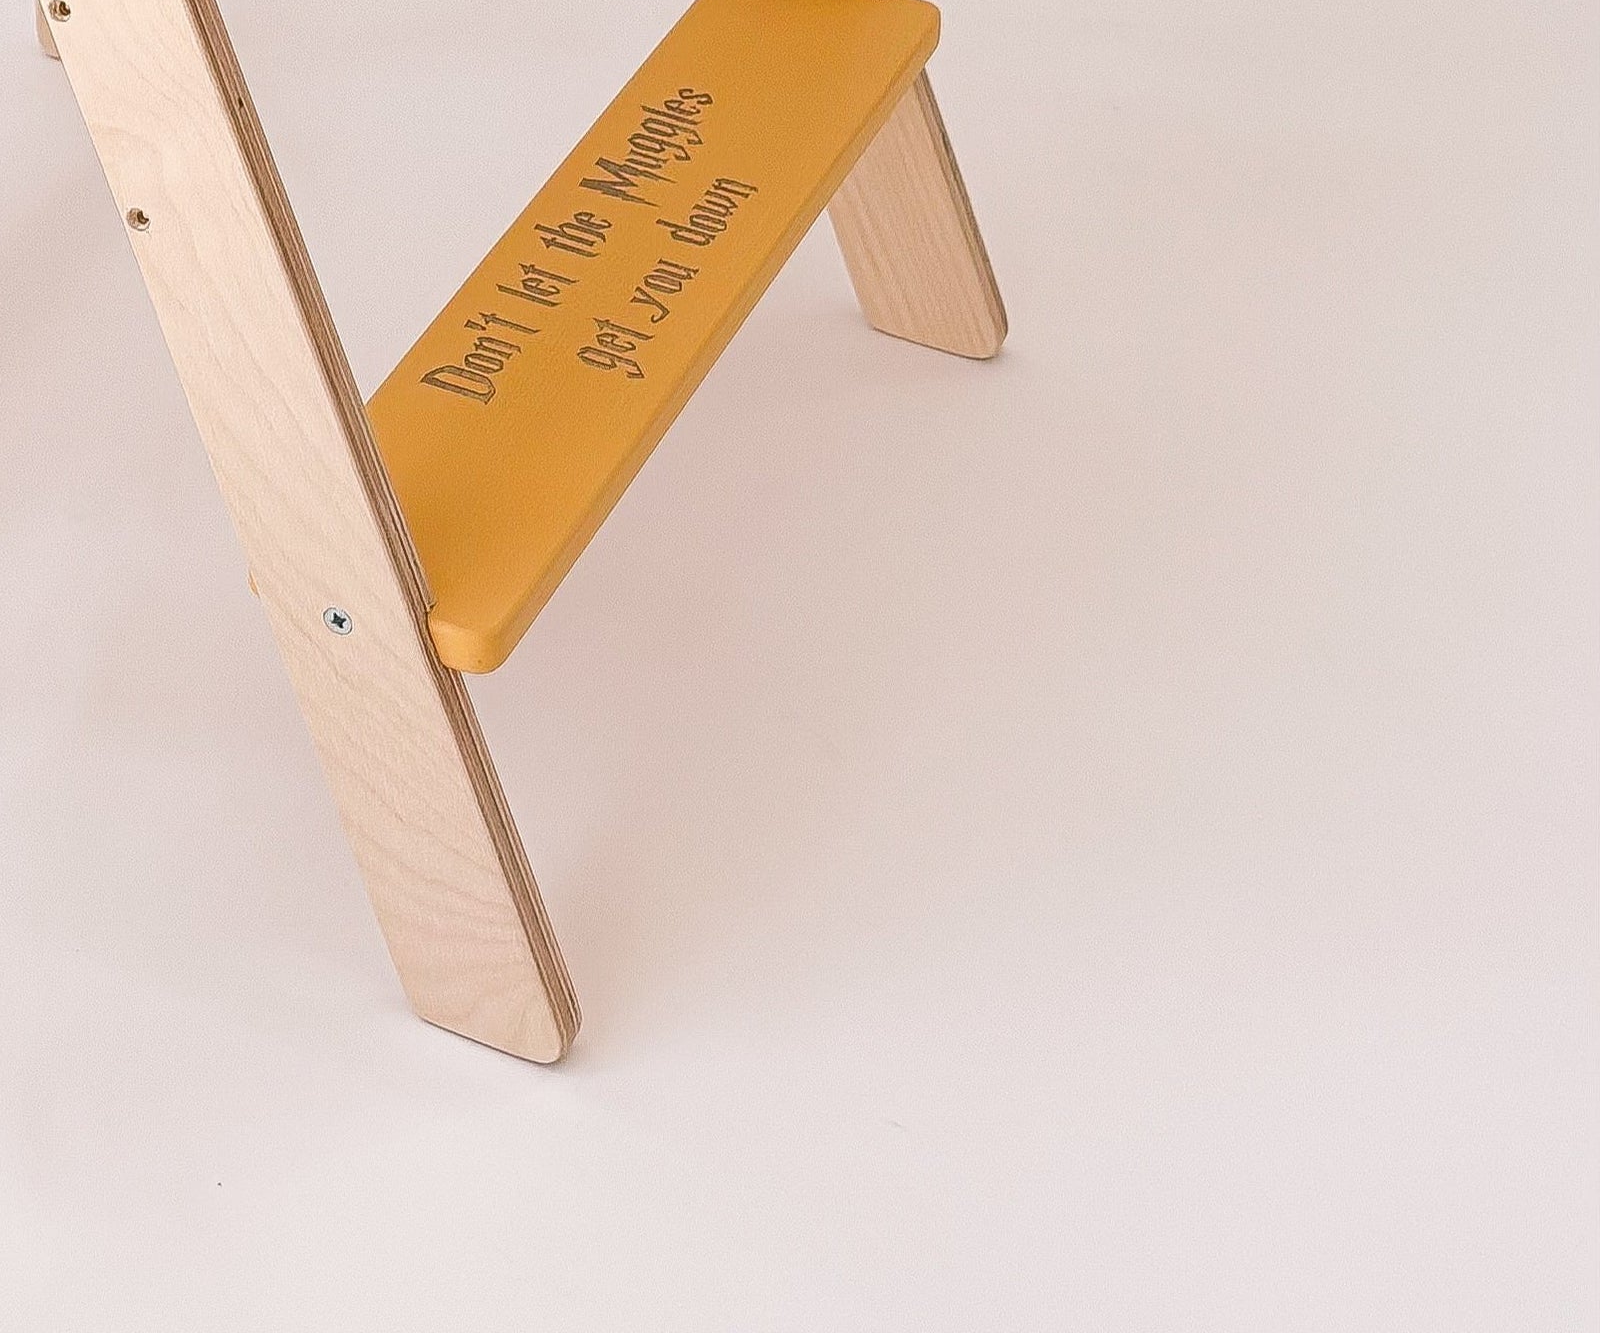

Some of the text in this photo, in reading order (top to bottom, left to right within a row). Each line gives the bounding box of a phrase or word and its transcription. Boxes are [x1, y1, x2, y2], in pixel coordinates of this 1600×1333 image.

[420, 87, 714, 404] Don't let the Muggles
[576, 177, 759, 379] get you down
